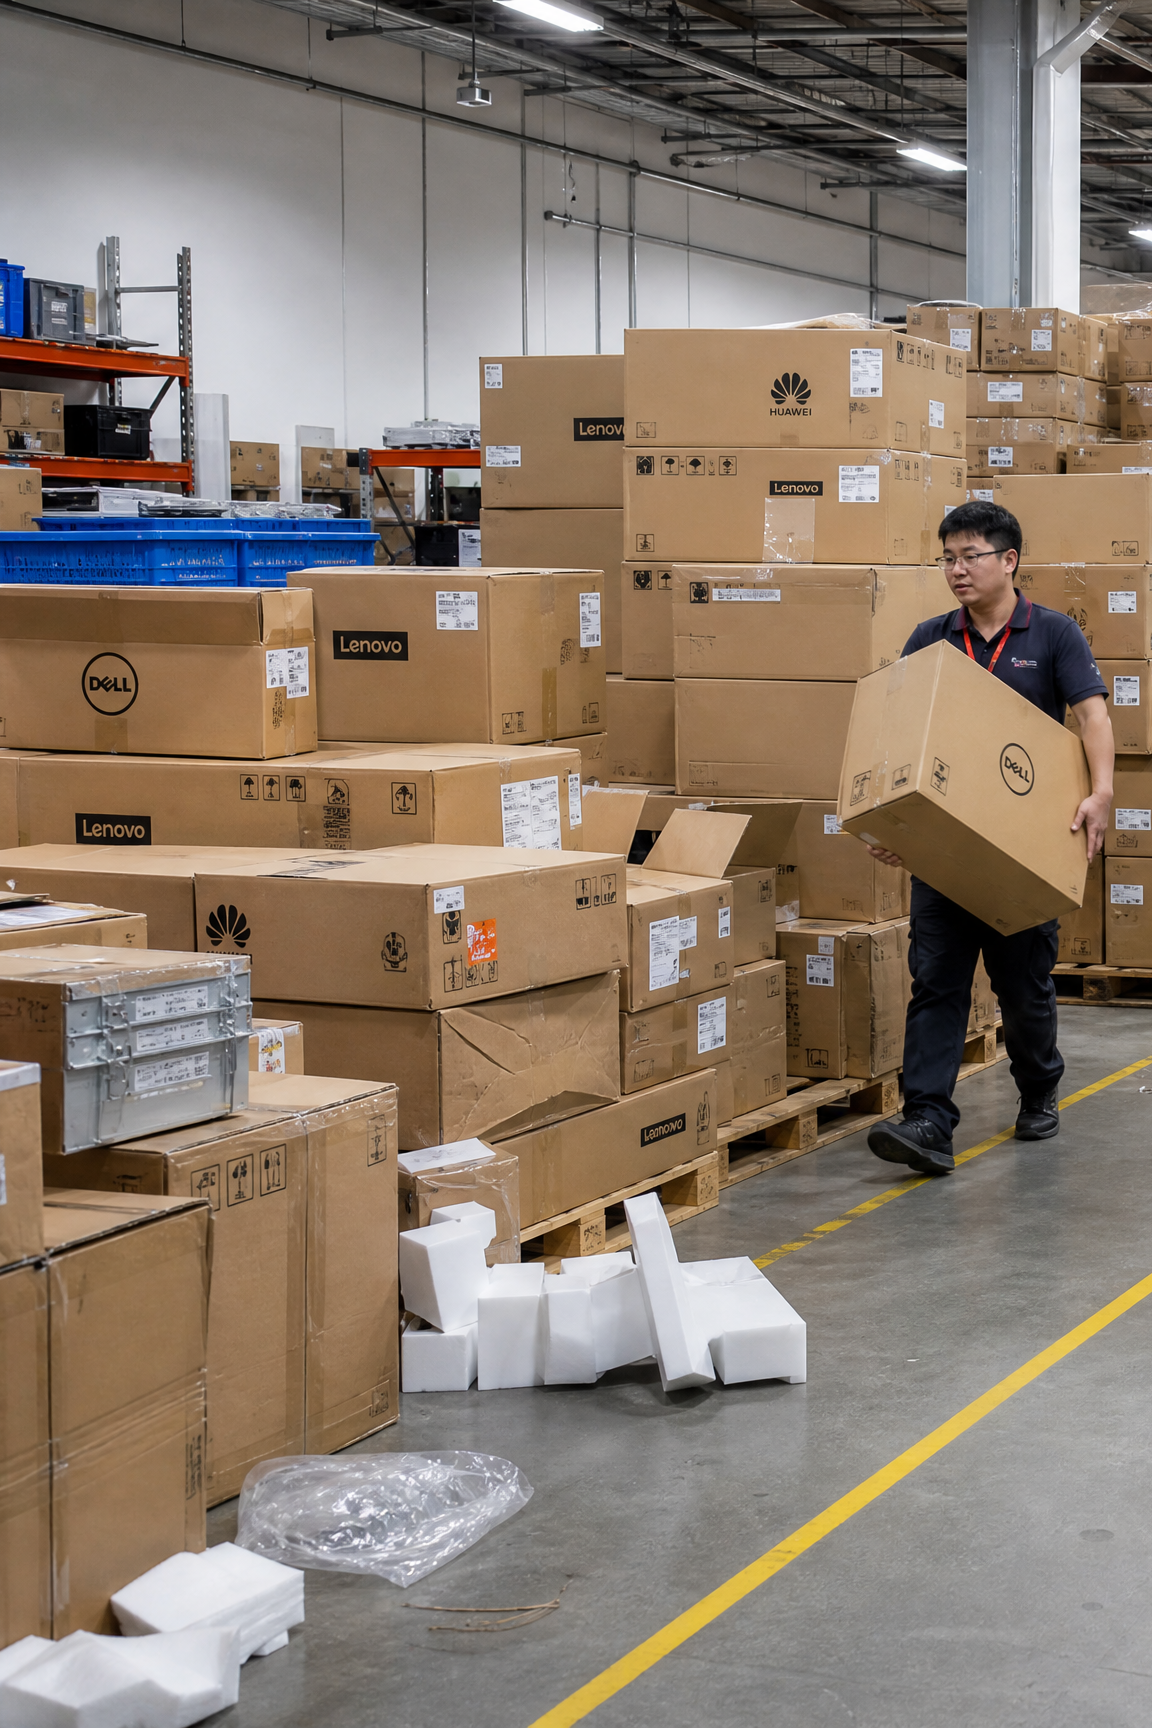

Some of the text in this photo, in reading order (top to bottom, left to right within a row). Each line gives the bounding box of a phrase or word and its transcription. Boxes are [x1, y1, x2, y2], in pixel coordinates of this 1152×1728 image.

[769, 408, 812, 416] HUAWEI
[579, 421, 625, 436] Lenov
[774, 482, 819, 494] Lenovo
[340, 636, 402, 654] Lenovo
[89, 676, 132, 692] DELL
[1004, 755, 1030, 783] DELL
[83, 819, 145, 839] Lenovo
